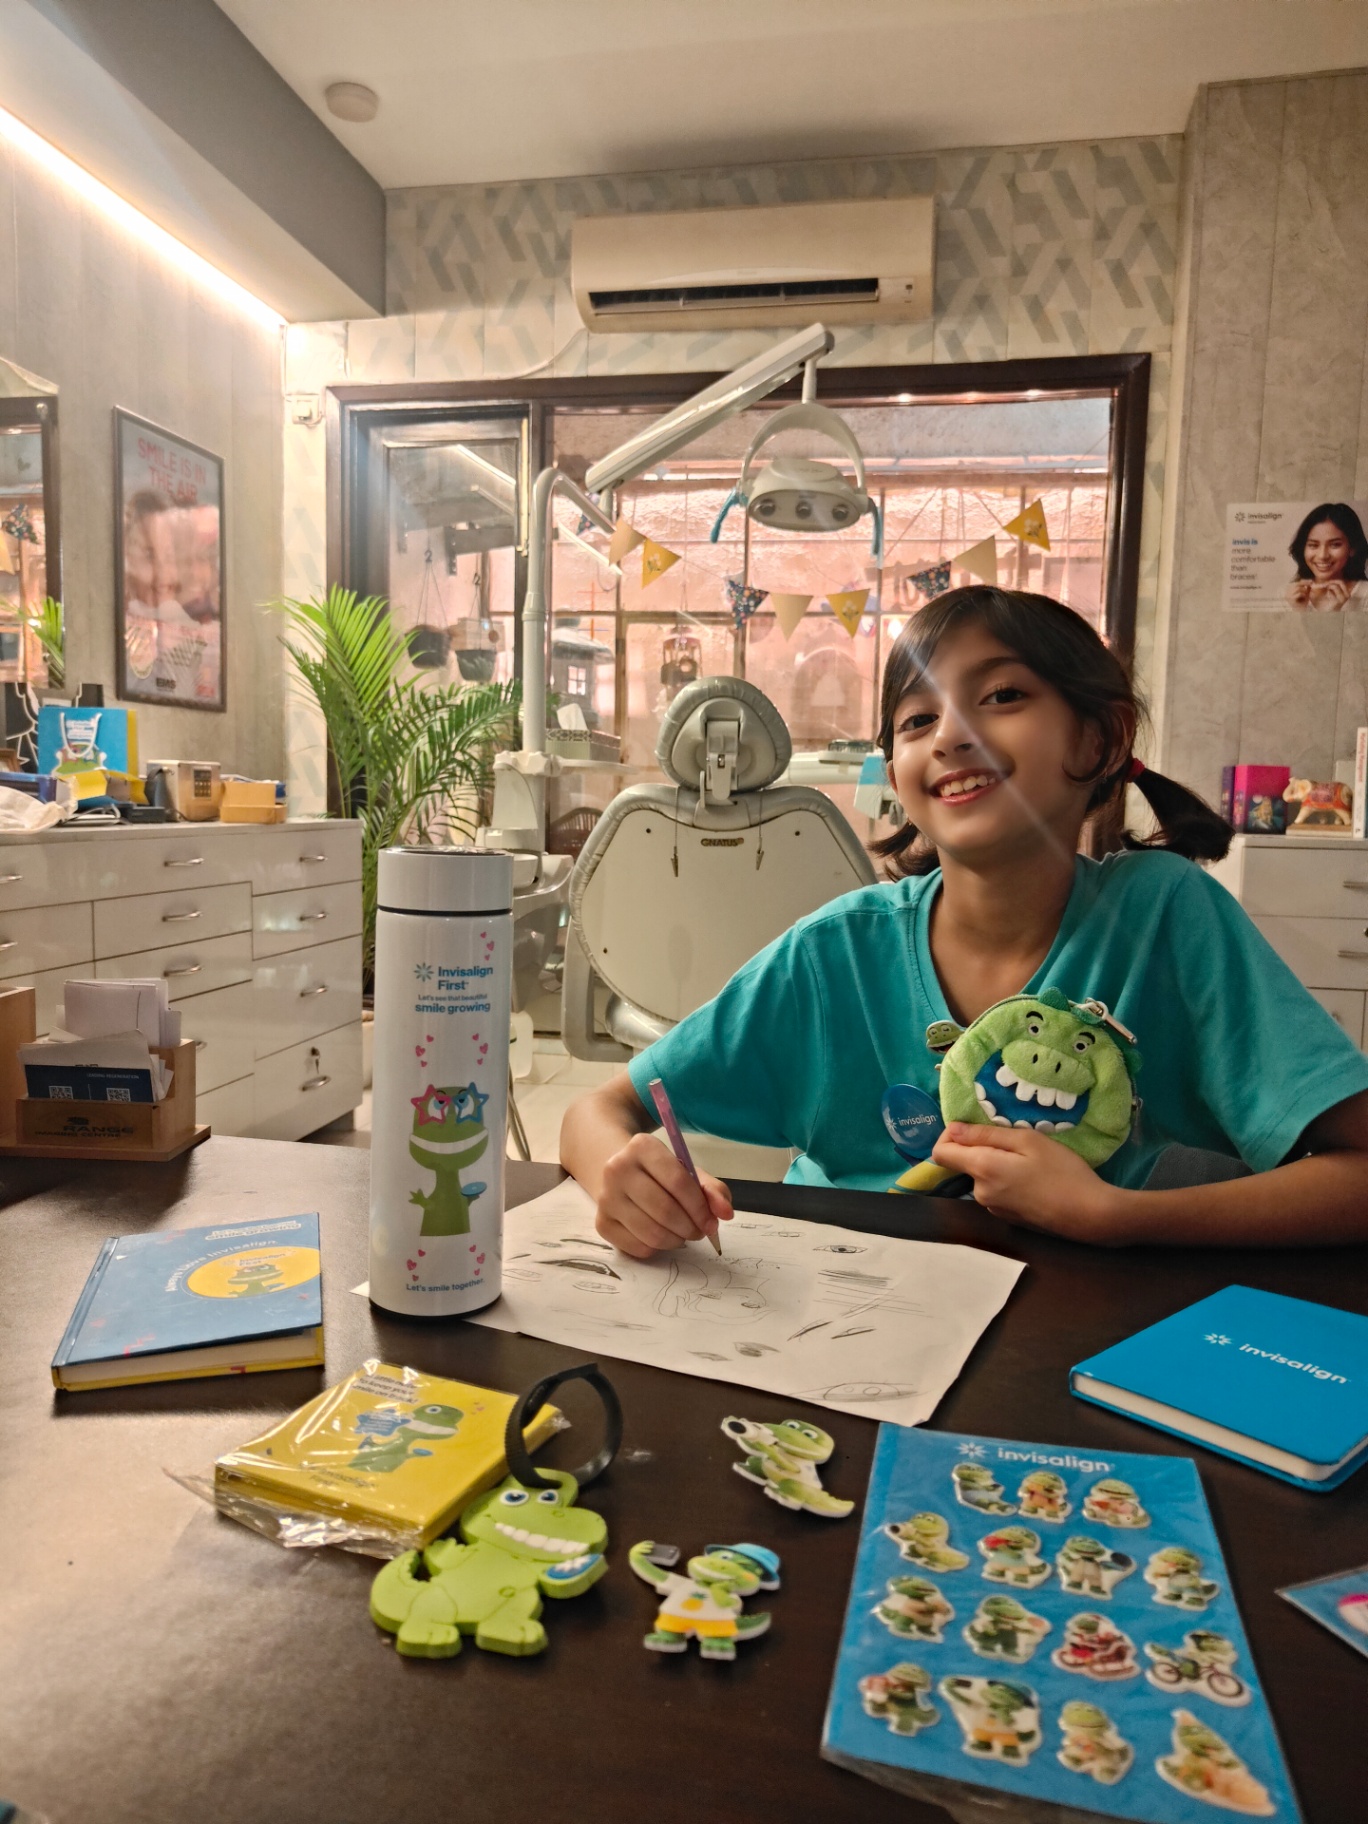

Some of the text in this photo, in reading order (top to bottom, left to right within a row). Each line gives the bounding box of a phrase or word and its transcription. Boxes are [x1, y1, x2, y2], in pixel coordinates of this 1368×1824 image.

[1247, 512, 1282, 521] invisalign
[701, 838, 741, 847] GNATUS
[438, 965, 494, 978] Invisalign
[415, 1002, 491, 1015] smile growing
[897, 1114, 937, 1126] invisalign
[63, 1125, 134, 1134] RANGE
[406, 1283, 426, 1292] Let's
[428, 1284, 450, 1292] smile
[1239, 1344, 1348, 1384] invisalign
[998, 1447, 1111, 1473] invisalign
